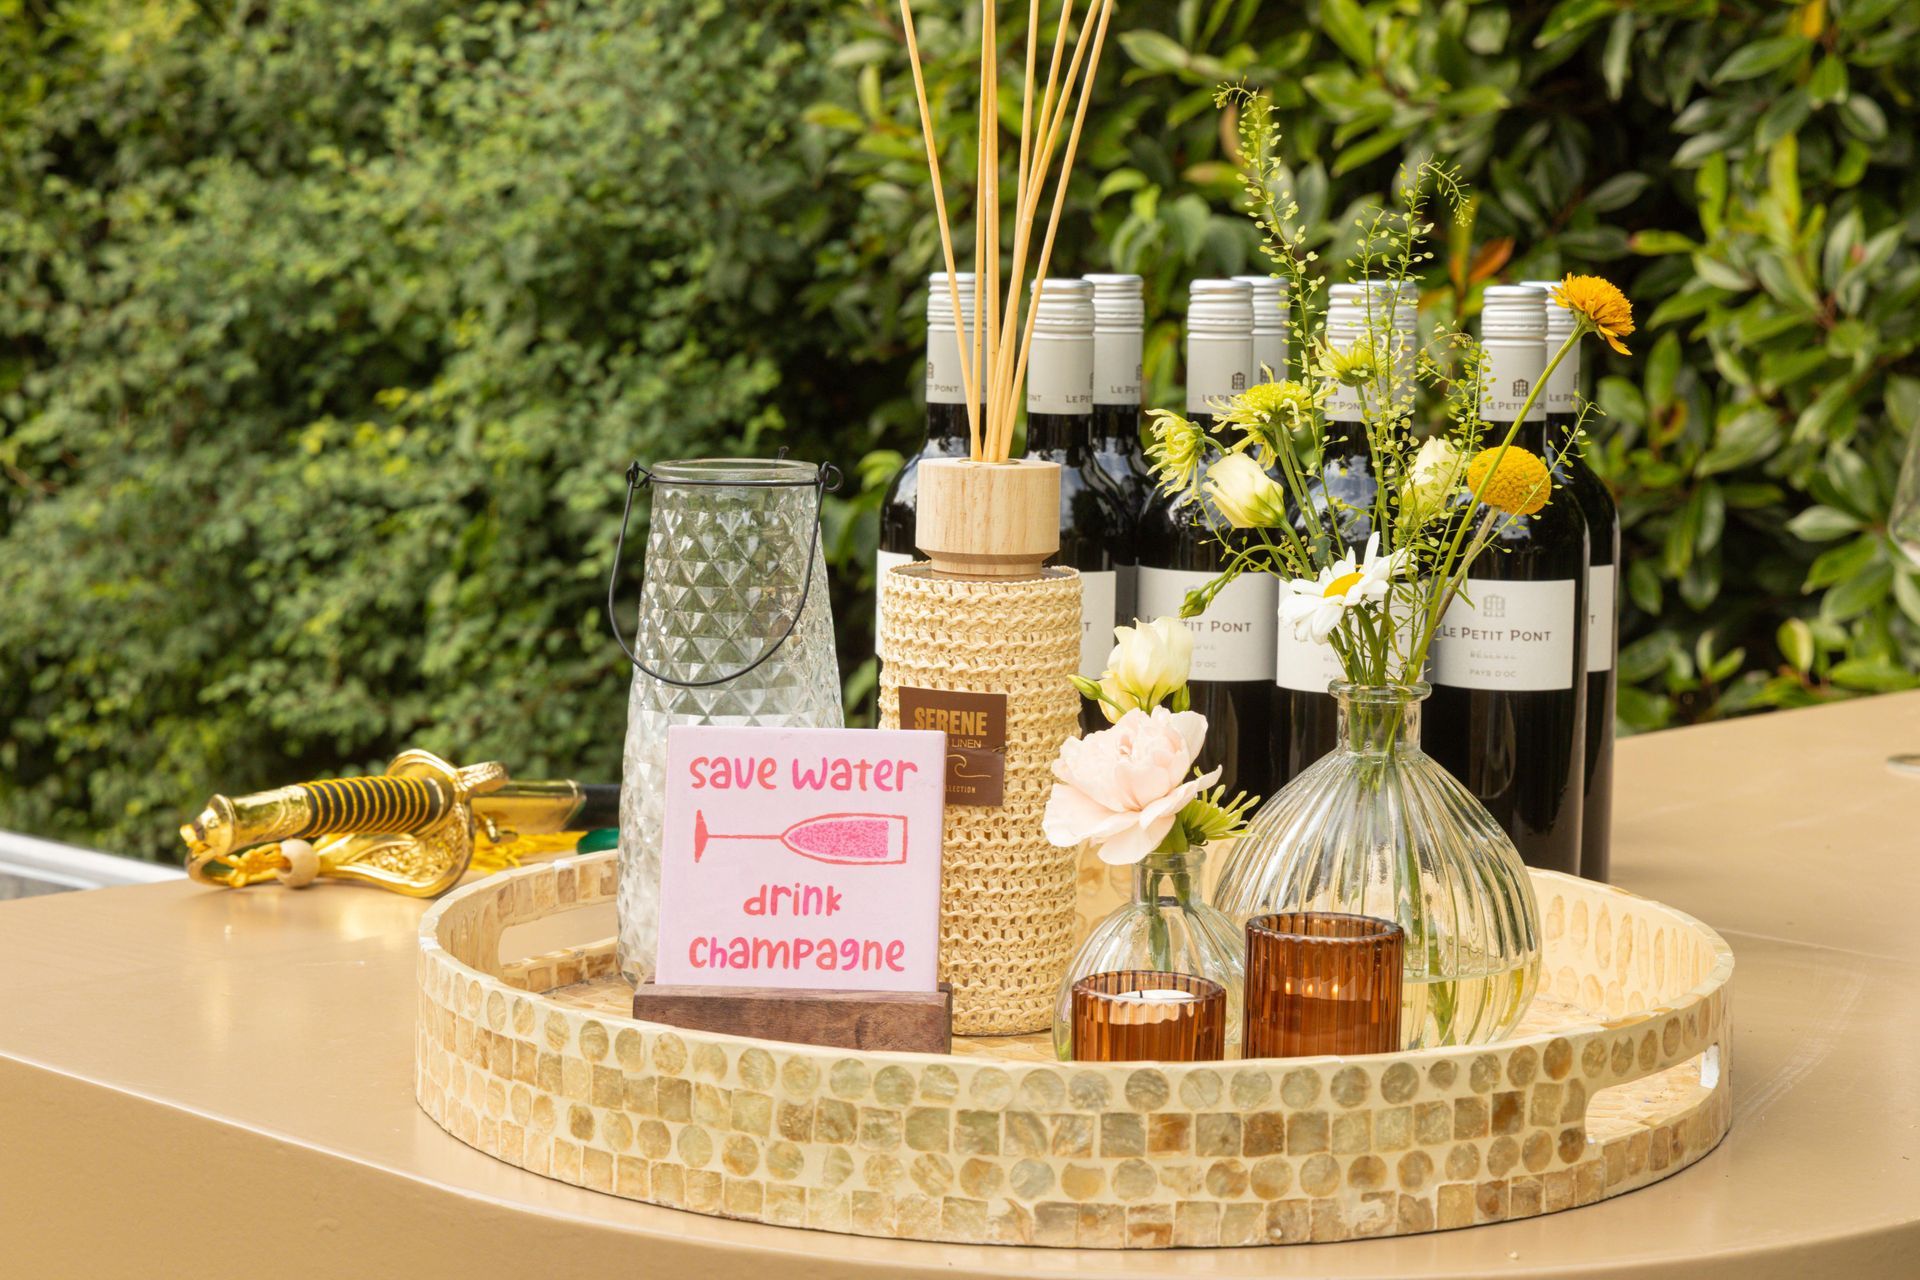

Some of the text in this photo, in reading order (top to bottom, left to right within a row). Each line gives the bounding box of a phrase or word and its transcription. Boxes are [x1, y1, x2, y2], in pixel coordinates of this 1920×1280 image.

[934, 384, 959, 393] PONT
[1110, 385, 1123, 394] LE
[1066, 395, 1078, 403] LE
[1549, 394, 1562, 402] LE
[1211, 620, 1252, 633] PONT
[1443, 625, 1552, 641] LE PETIT PONT
[914, 706, 988, 736] SERENE
[951, 739, 981, 749] LINEN
[689, 756, 919, 792] save water
[743, 882, 842, 916] drink
[688, 936, 906, 972] champagne
